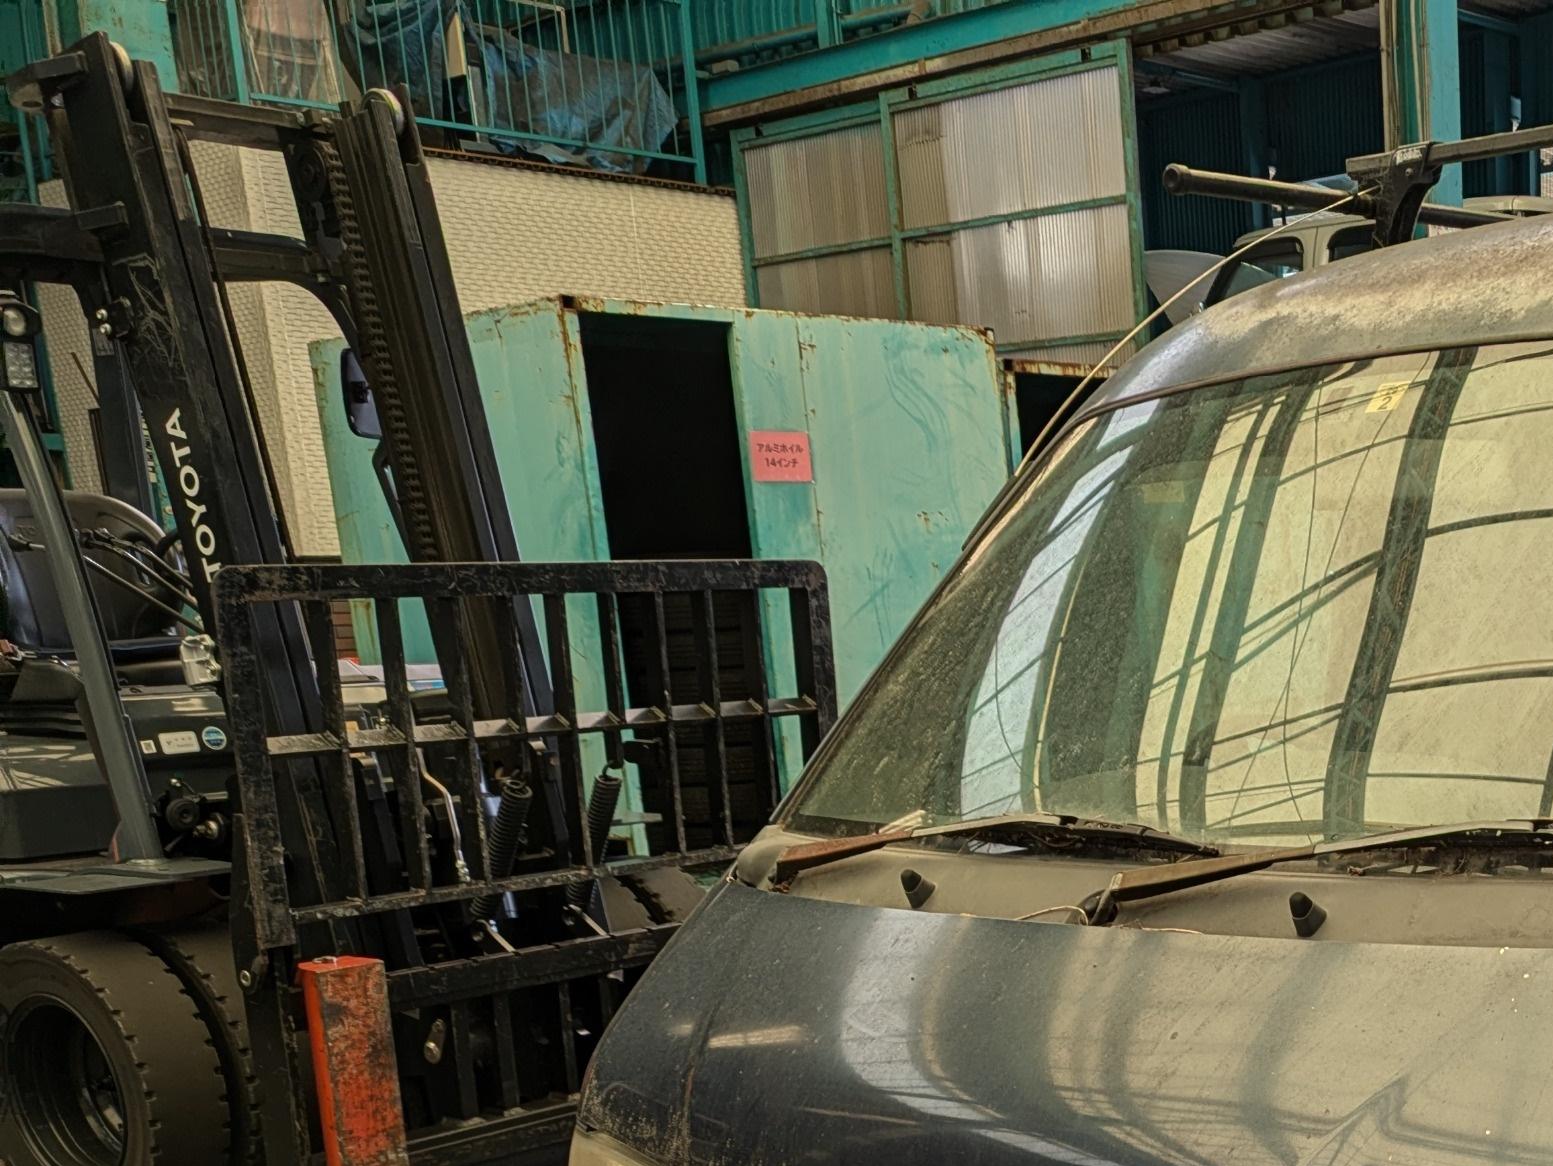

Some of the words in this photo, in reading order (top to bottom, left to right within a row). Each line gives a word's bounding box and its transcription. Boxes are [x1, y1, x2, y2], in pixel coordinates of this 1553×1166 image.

[165, 407, 222, 584] TOYOTA
[764, 457, 799, 468] 14インチ
